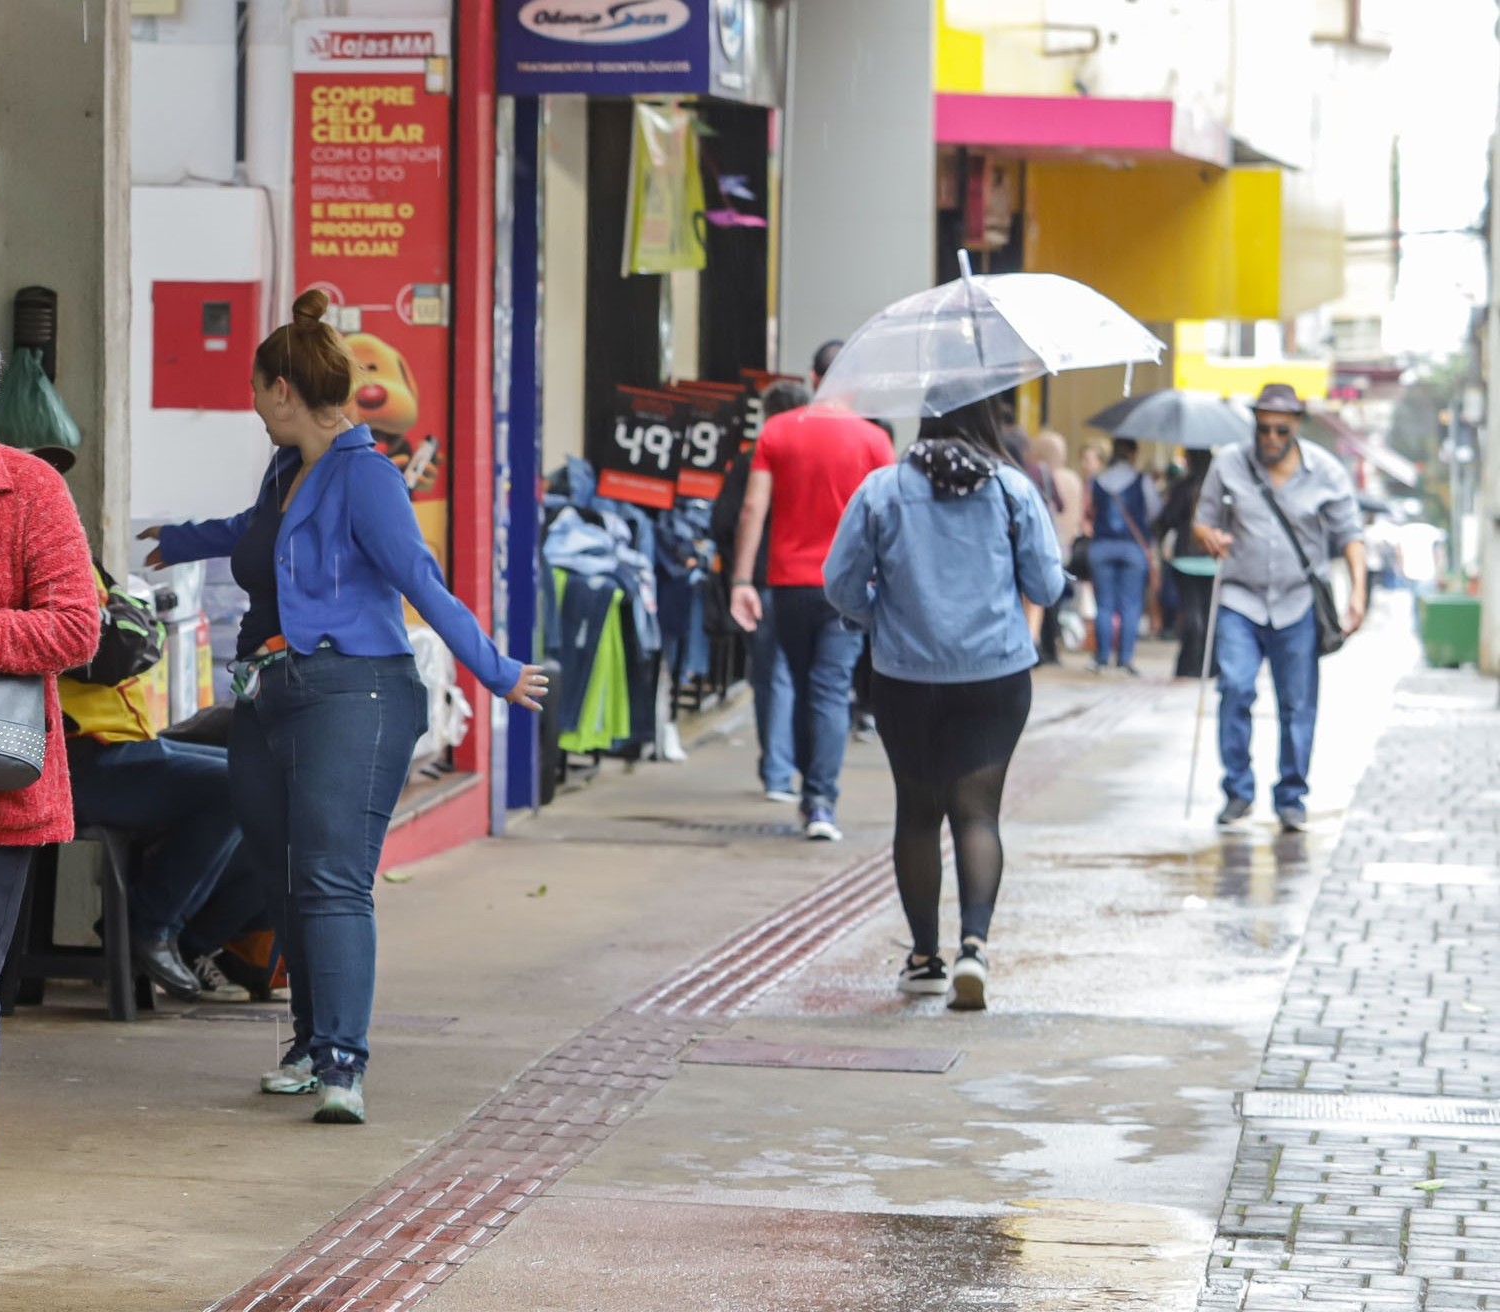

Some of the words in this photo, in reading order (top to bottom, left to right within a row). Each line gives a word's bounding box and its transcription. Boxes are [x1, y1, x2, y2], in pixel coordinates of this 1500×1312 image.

[311, 86, 415, 105] COMPRE
[311, 105, 376, 124] PELO
[311, 124, 425, 143] CELULAR
[311, 147, 353, 162] COM
[355, 146, 372, 163] O
[375, 147, 441, 163] MENOR
[311, 165, 373, 182] PREÇO
[375, 165, 406, 182] DO
[311, 183, 373, 200] BRASIL
[311, 202, 324, 218] E
[327, 202, 395, 218] RETIRE
[397, 202, 415, 219] O
[311, 221, 405, 238] PRODUTO
[311, 241, 341, 256] NA
[343, 240, 399, 256] LOJA!
[615, 422, 674, 471] 49
